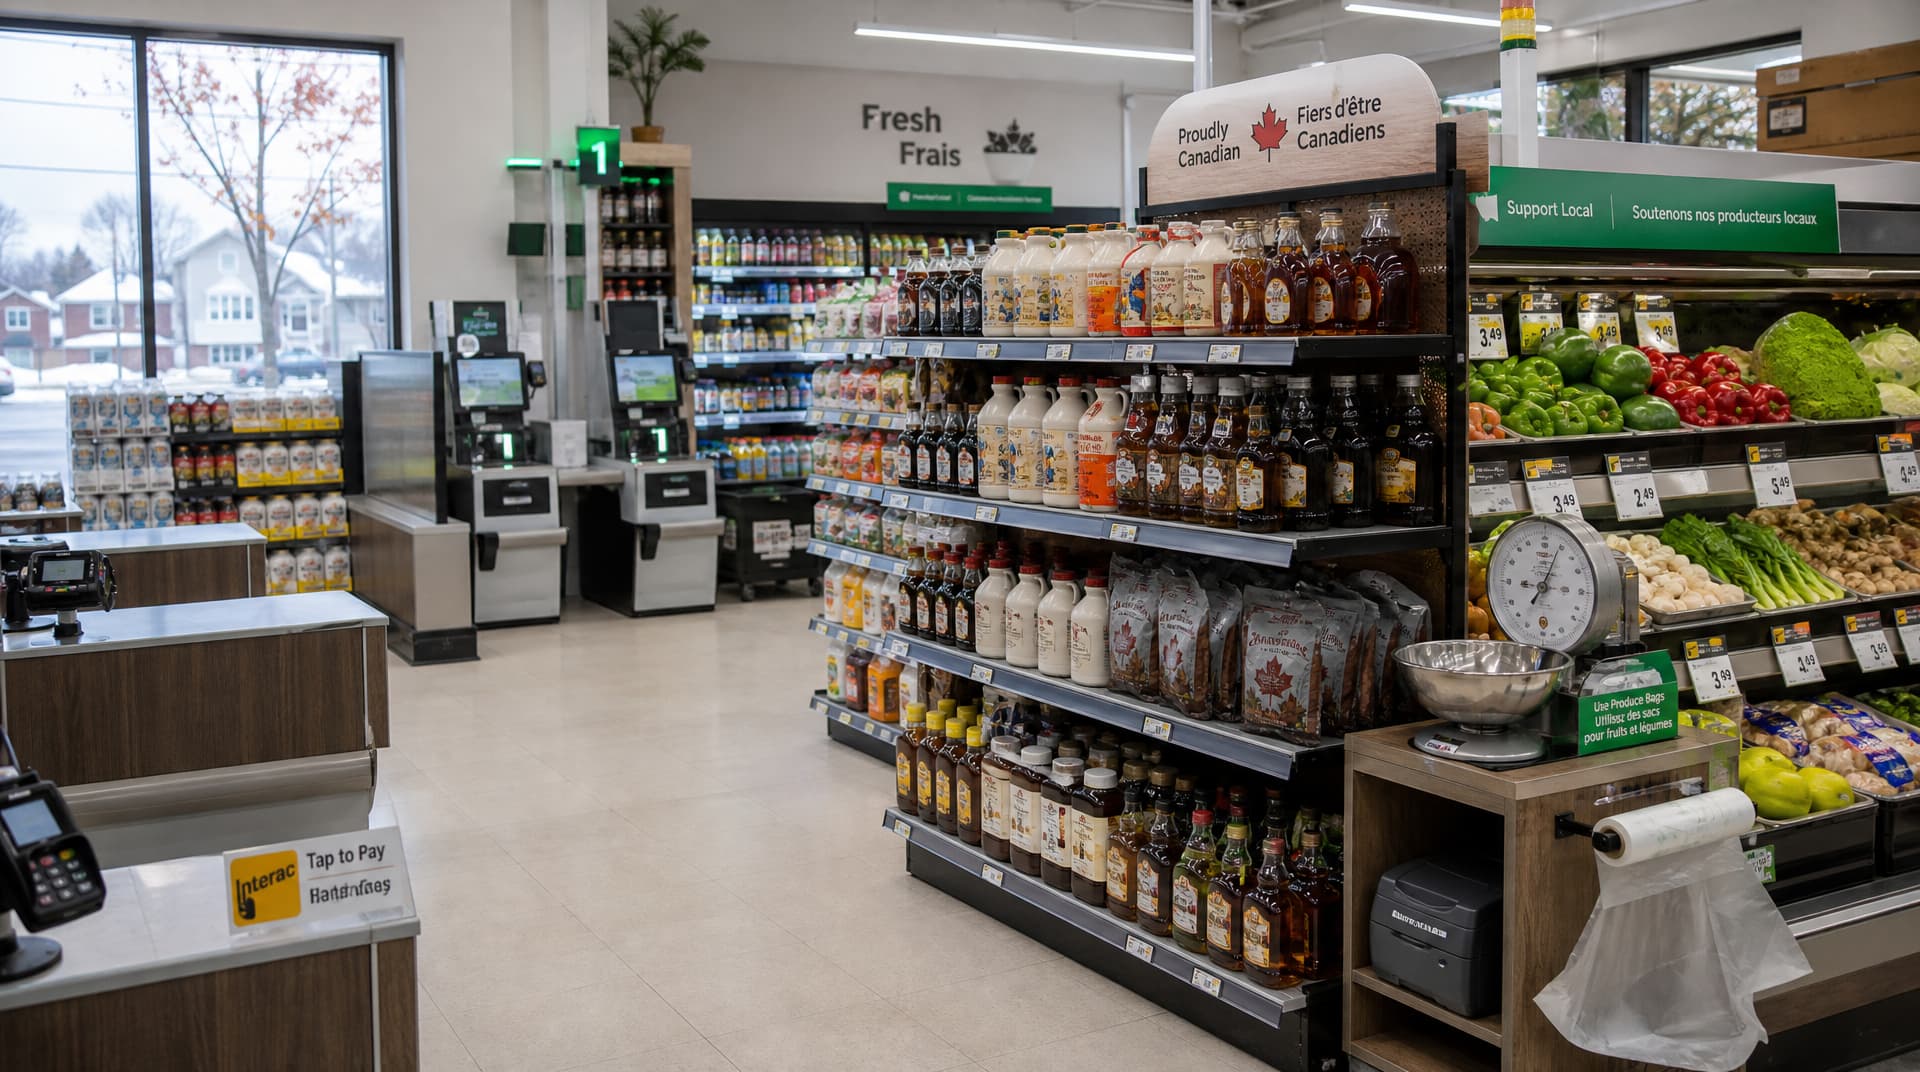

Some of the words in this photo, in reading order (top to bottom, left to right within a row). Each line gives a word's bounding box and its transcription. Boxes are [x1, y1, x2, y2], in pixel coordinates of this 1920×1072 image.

[862, 104, 942, 133] Fresh
[1297, 104, 1332, 125] Fiers
[1335, 96, 1382, 119] d'être
[1178, 120, 1229, 145] Proudly
[1297, 122, 1386, 151] Canadiens
[591, 141, 607, 175] 1
[900, 141, 961, 167] Frais
[1178, 144, 1241, 168] Canadian
[1507, 200, 1558, 219] Support
[1561, 202, 1593, 217] Local
[1632, 204, 1693, 221] Soutenons
[1696, 210, 1715, 222] nos
[1718, 209, 1782, 225] producteurs
[1784, 210, 1817, 225] locaux
[1610, 696, 1644, 710] Produce
[1646, 692, 1665, 705] Bags
[1627, 709, 1641, 721] des
[1642, 707, 1660, 719] sacs
[1584, 731, 1606, 746] pour
[1607, 726, 1627, 740] fruits
[1629, 725, 1638, 735] et
[1640, 719, 1673, 735] légumes
[306, 852, 334, 871] Tap
[340, 849, 354, 864] to
[359, 844, 386, 862] Pay
[236, 863, 295, 902] Interac
